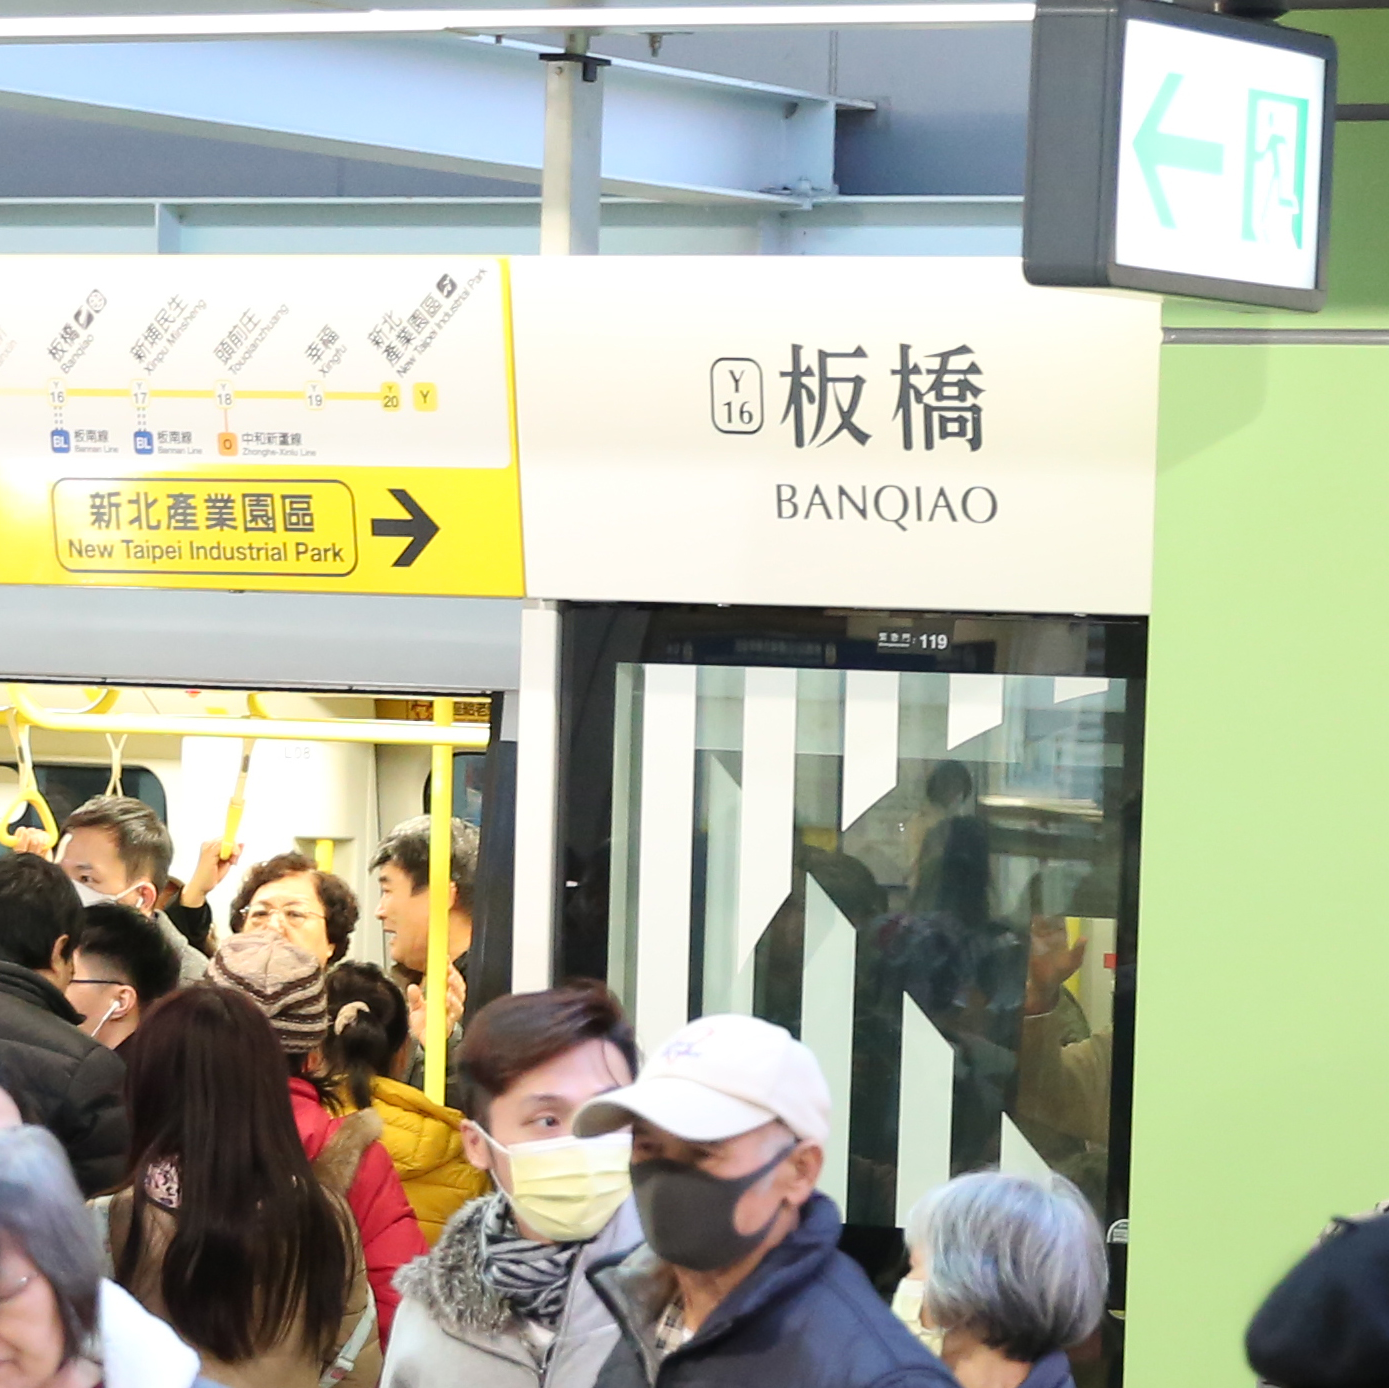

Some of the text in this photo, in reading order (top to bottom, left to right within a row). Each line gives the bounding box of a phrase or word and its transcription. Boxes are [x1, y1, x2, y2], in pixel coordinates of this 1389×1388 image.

[129, 293, 190, 364] 新埔民生
[213, 307, 262, 365] 頭前庄
[368, 310, 403, 350] 新北
[47, 322, 81, 364] 板橋
[60, 334, 95, 375] Banqiao
[305, 323, 340, 365] 幸福
[728, 369, 745, 394] Y
[50, 392, 65, 403] 16
[133, 393, 147, 404] 17
[217, 394, 232, 405] 18
[308, 395, 322, 407] 19
[383, 396, 399, 408] 20
[420, 390, 430, 404] Y
[779, 343, 986, 453] 板橋
[722, 400, 753, 426] 16
[53, 436, 68, 448] BL
[136, 437, 152, 450] BL
[89, 491, 316, 535] 新北產業園區
[775, 483, 998, 532] BANQIAO
[68, 539, 345, 564] New Taipei Industrial Park
[919, 634, 948, 650] 119
